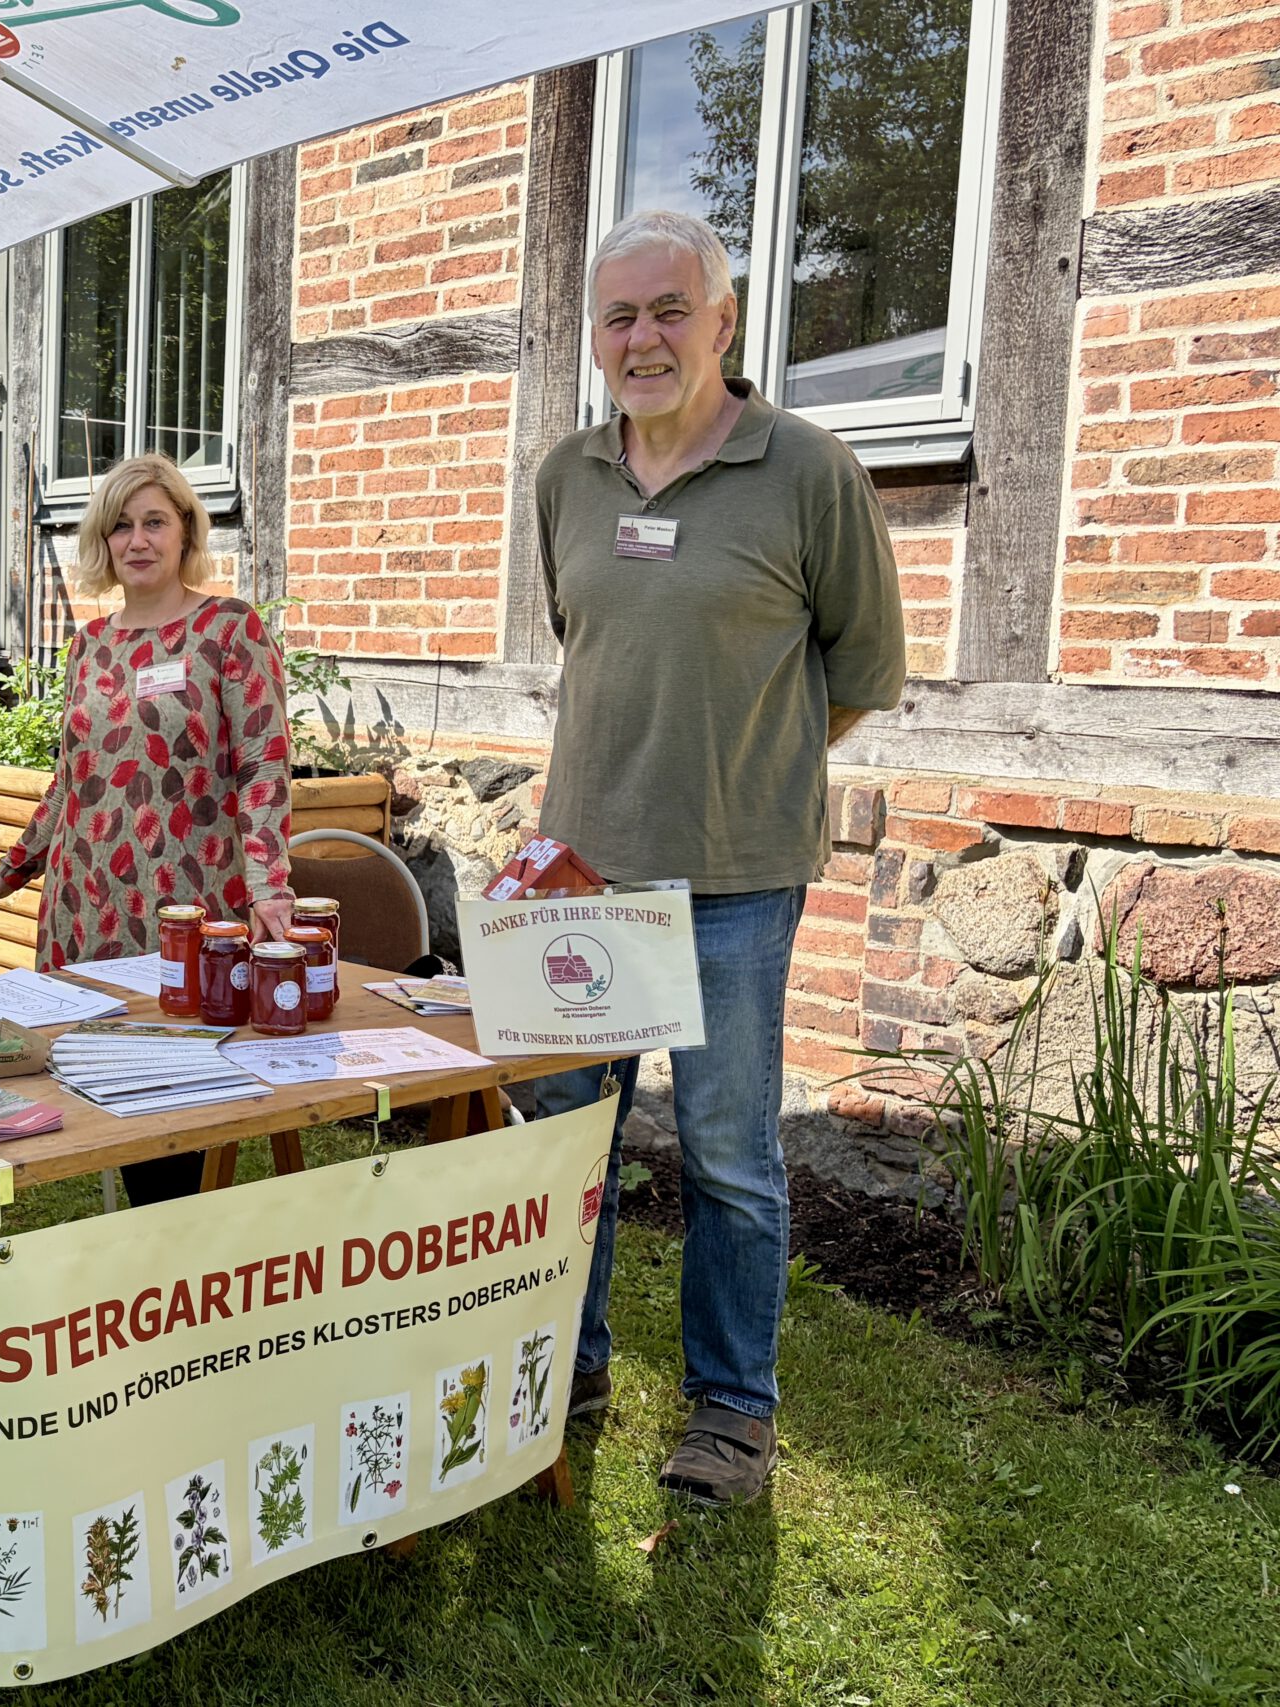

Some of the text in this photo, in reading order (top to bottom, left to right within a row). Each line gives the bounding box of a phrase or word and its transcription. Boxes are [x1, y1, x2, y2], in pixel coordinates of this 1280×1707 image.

[480, 906, 671, 937] DANKE FÜR IHRE SPENDE!
[498, 1021, 682, 1045] FÜR UNSEREN KLOSTERGARTEN!!!
[341, 1193, 549, 1288] DOBERAN
[67, 1391, 118, 1429] UND
[124, 1344, 250, 1401] FÖRDERER
[258, 1328, 306, 1360] DES
[313, 1301, 441, 1346] KLOSTERS
[447, 1266, 540, 1316] DOBERAN
[544, 1256, 569, 1284] e.V.
